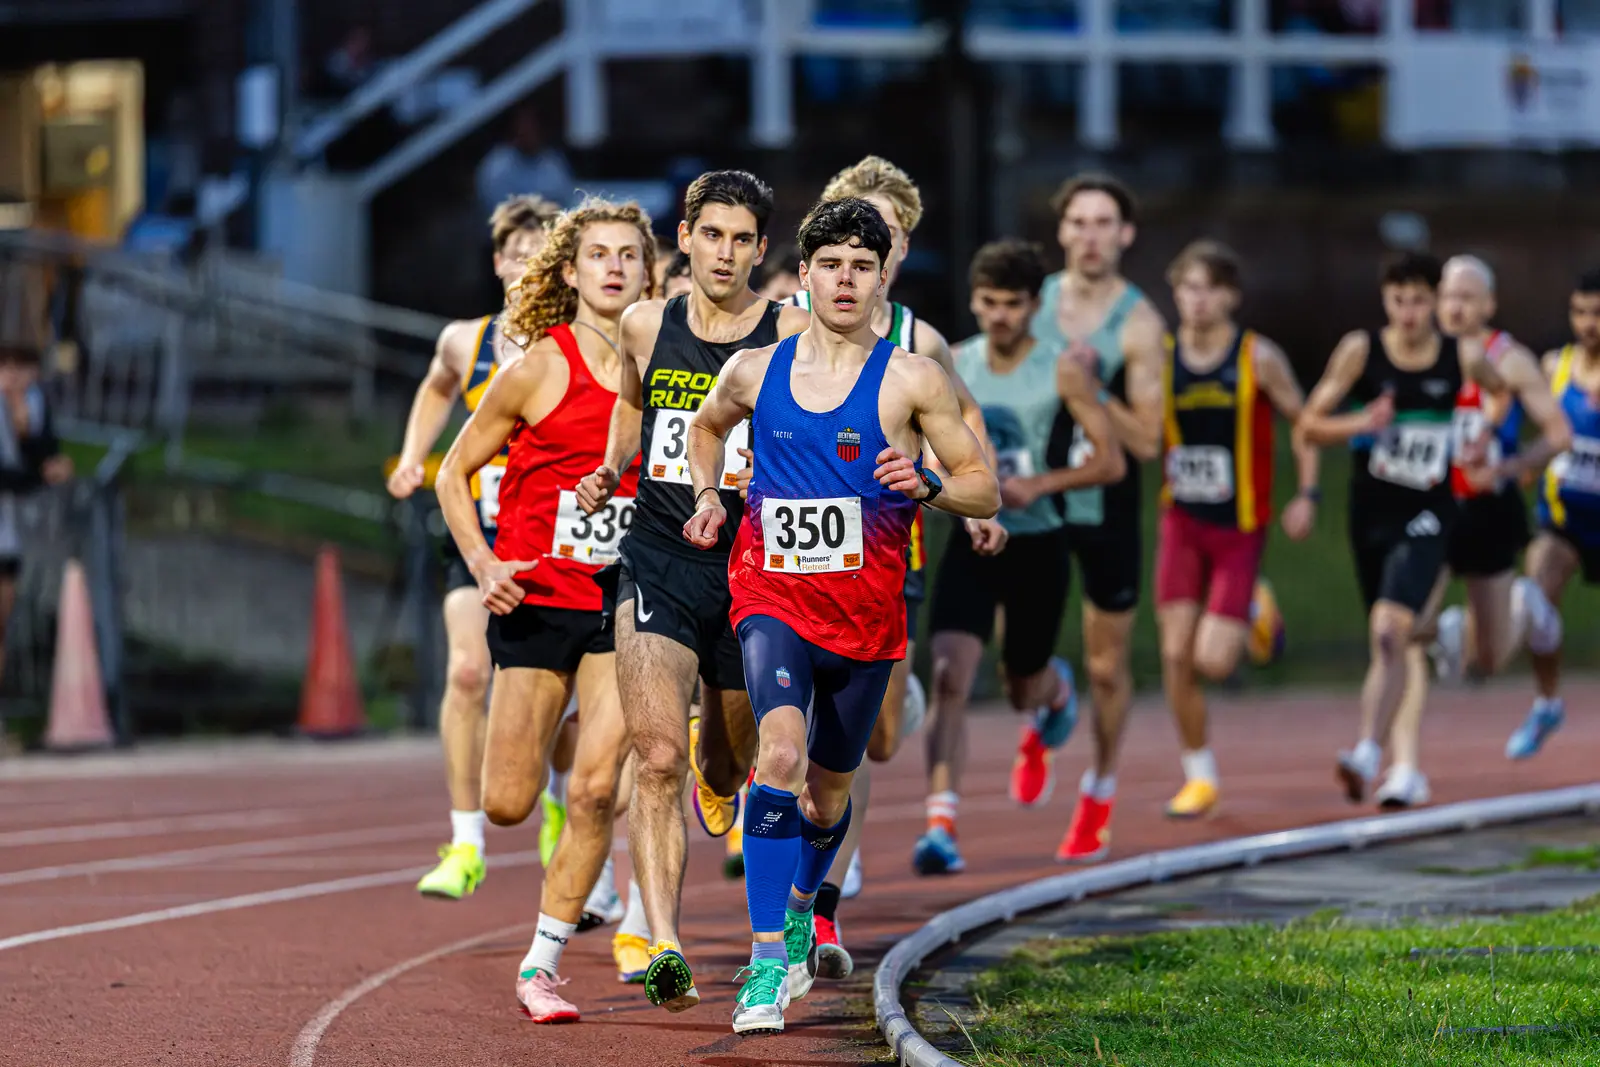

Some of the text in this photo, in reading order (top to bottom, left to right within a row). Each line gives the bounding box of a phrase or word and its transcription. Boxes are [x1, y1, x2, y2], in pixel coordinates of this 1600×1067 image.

[772, 430, 793, 439] TACTIC
[775, 505, 845, 550] 350
[801, 554, 832, 563] Runners'
[801, 563, 831, 571] Retreat
